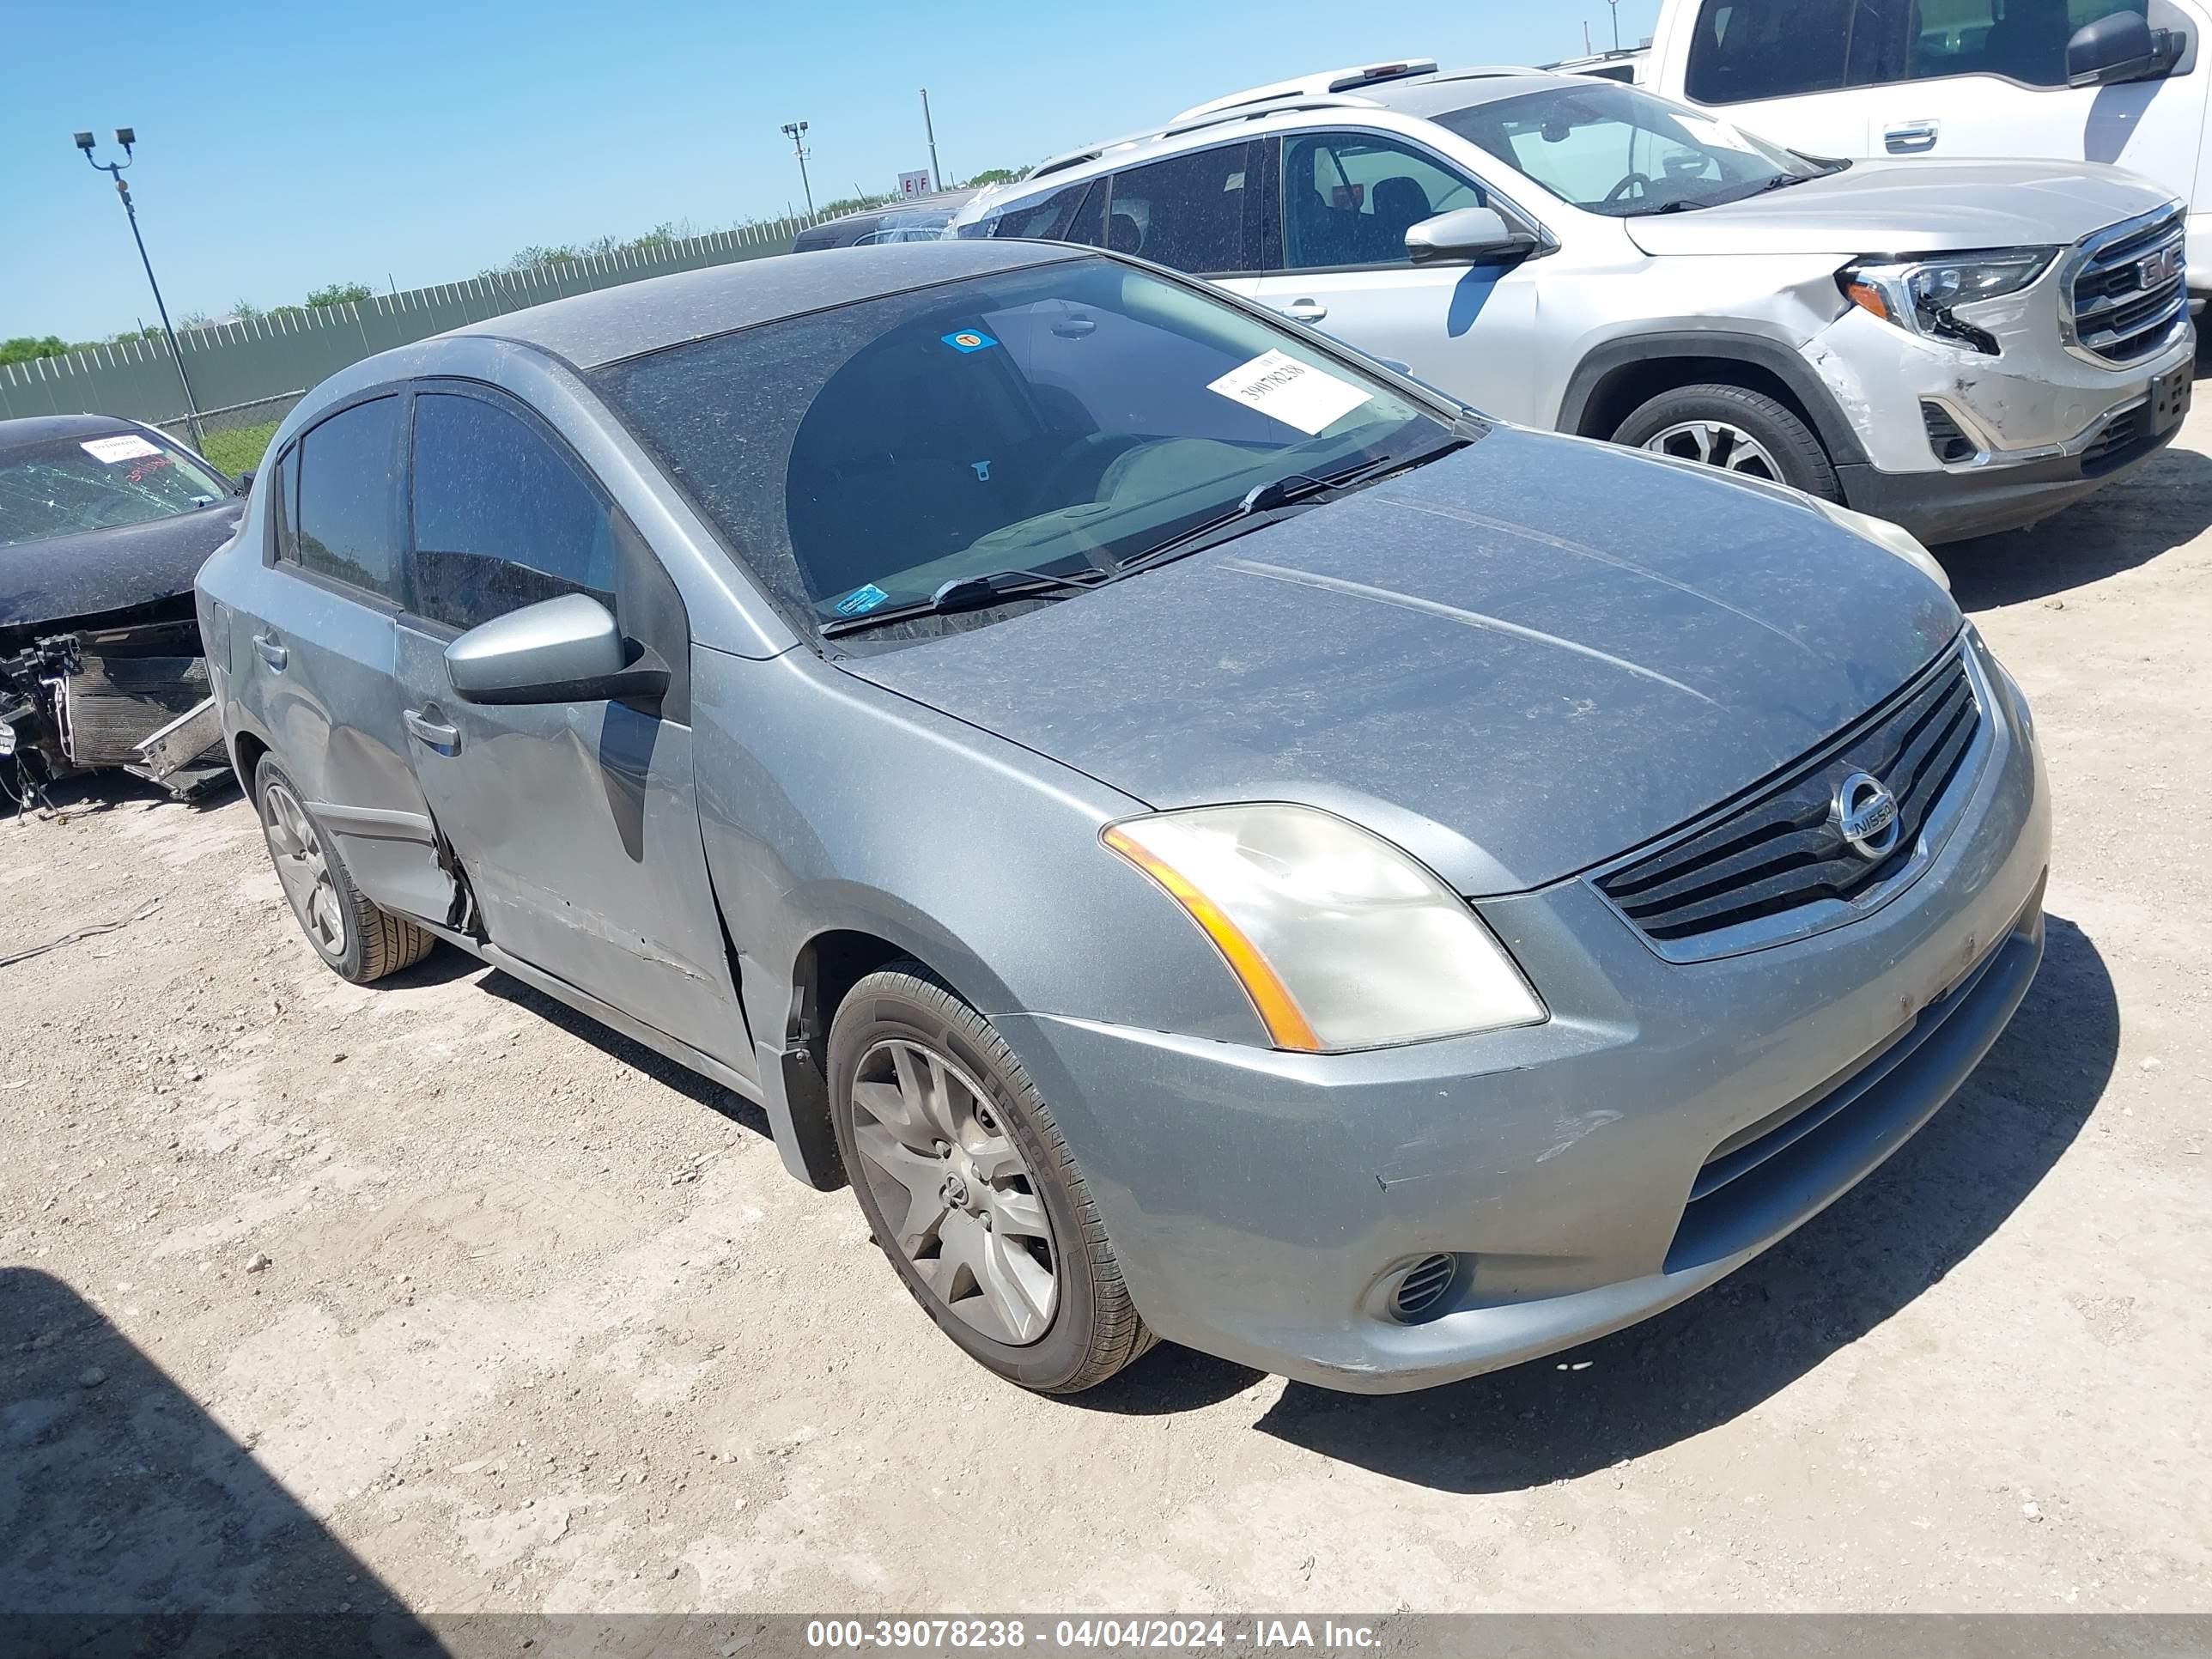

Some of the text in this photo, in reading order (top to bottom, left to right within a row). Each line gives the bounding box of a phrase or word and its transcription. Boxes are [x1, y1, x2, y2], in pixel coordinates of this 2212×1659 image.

[906, 177, 927, 192] E F
[1240, 364, 1306, 401] 39078238
